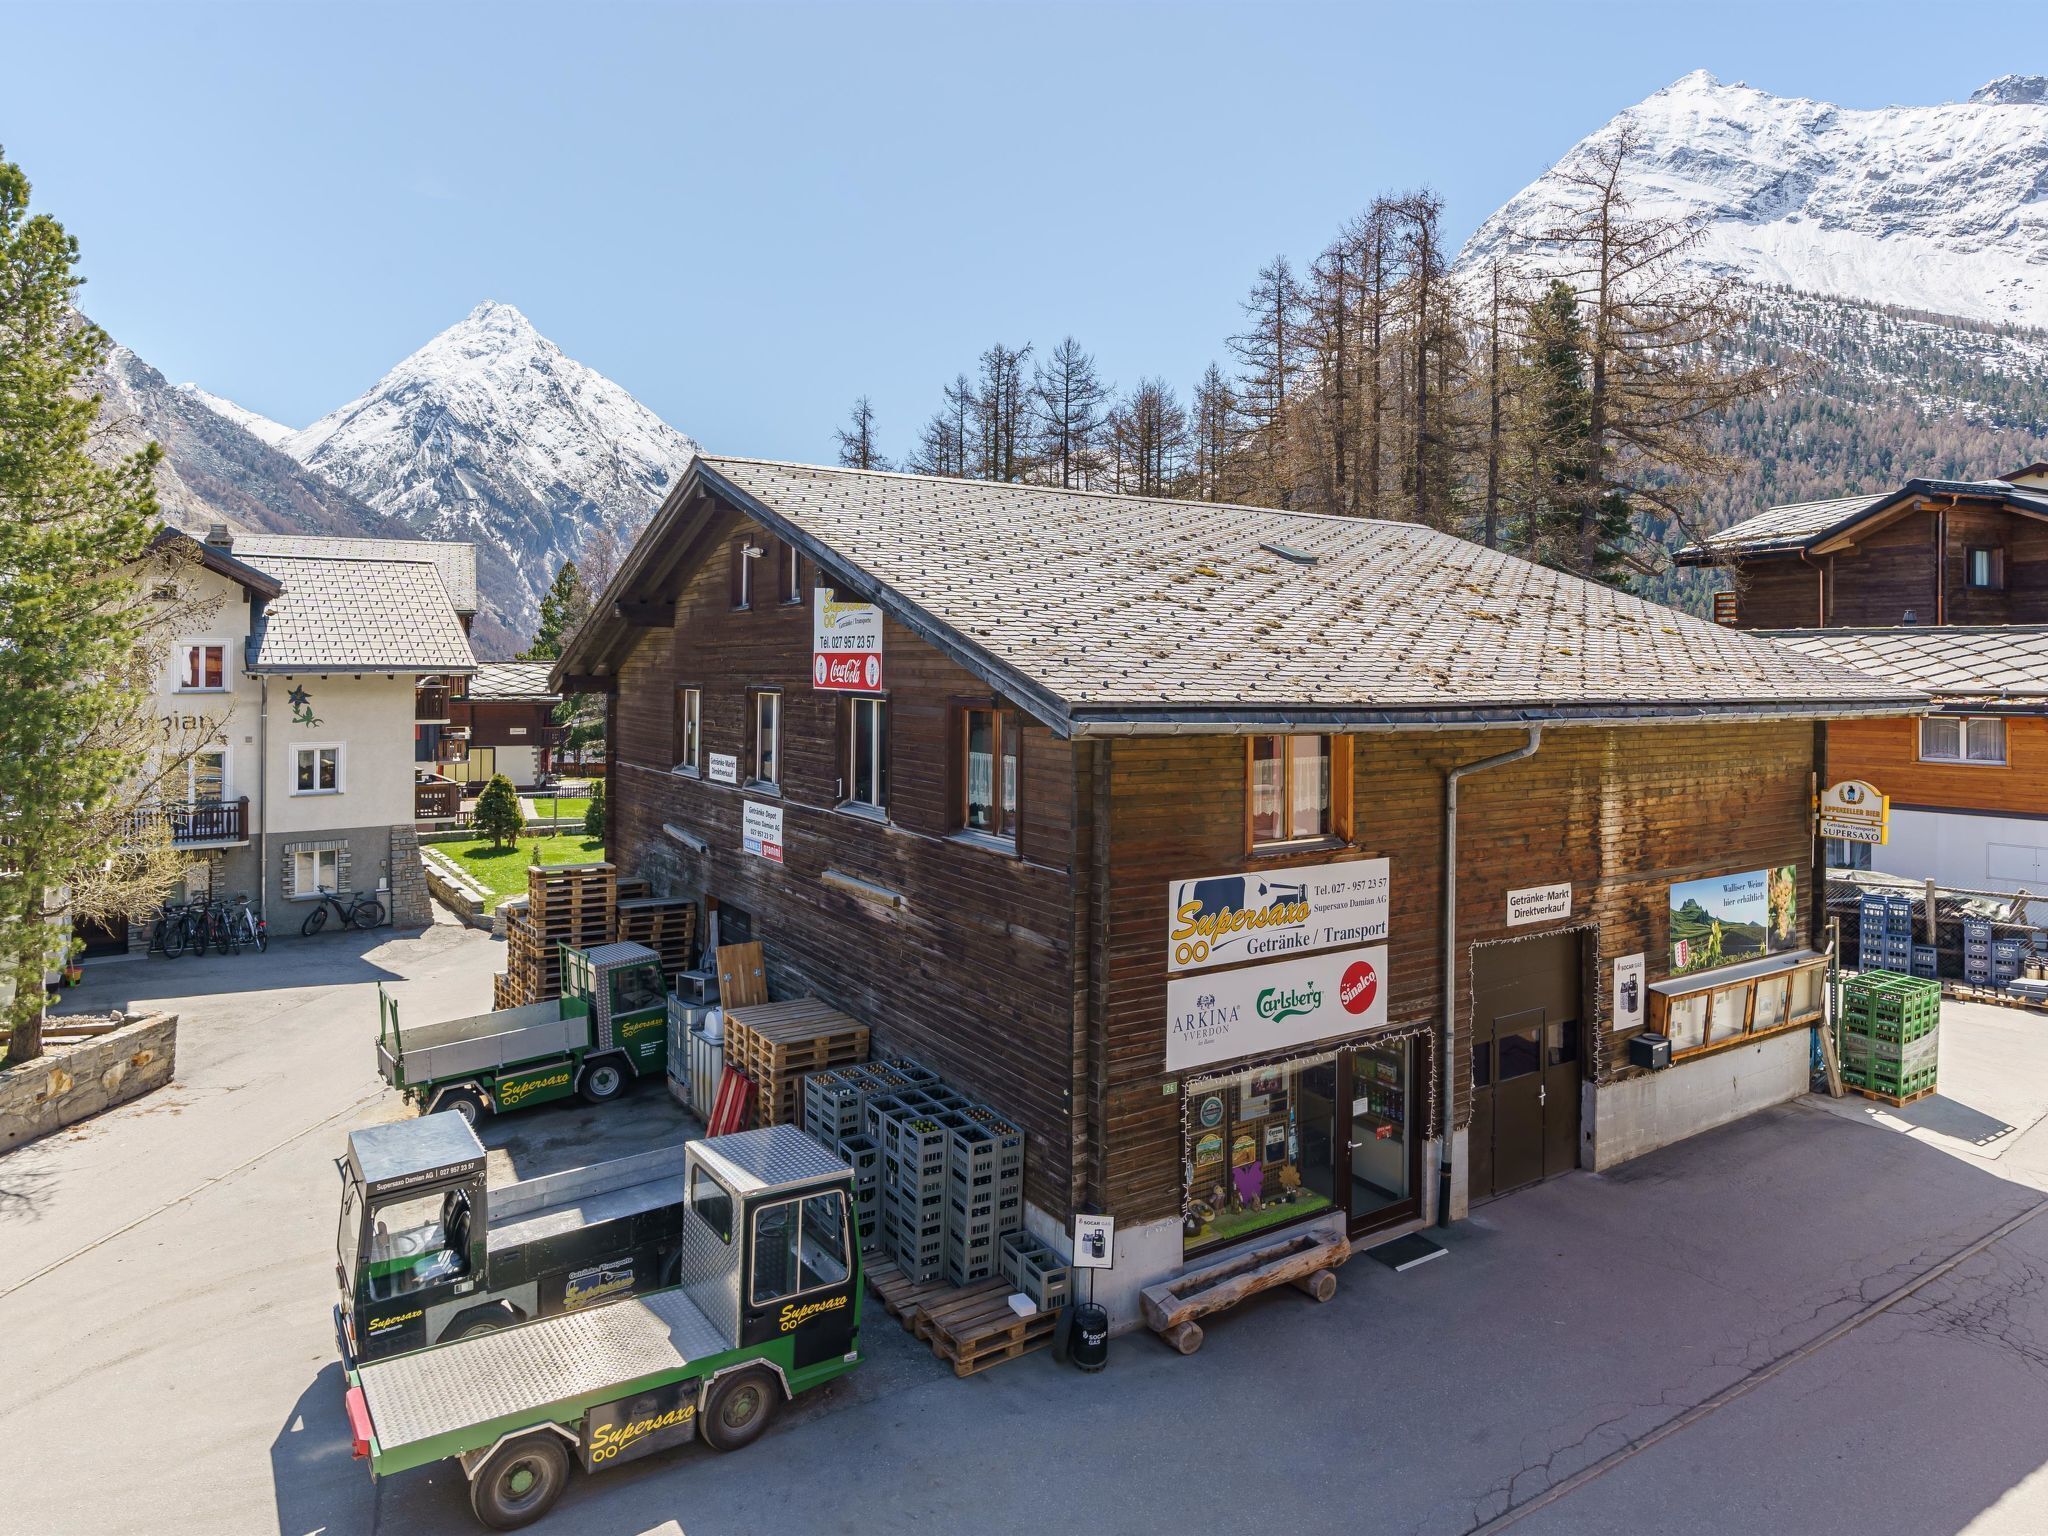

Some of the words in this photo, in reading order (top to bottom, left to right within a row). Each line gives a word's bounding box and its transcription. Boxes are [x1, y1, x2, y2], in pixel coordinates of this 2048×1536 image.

[820, 635, 830, 649] Tél.
[832, 635, 843, 649] 027
[844, 635, 856, 649] 957
[857, 635, 865, 649] 23
[867, 635, 875, 649] 57
[765, 810, 777, 820] Depot
[1823, 828, 1880, 842] SUPERSAXO
[1314, 884, 1331, 896] Tel.
[1332, 882, 1345, 894] 027
[1352, 880, 1366, 891] 957
[1368, 879, 1378, 889] 23
[1378, 877, 1388, 888] 57
[1723, 883, 1746, 893] Walliser
[1747, 879, 1764, 889] Weine
[1313, 902, 1348, 913] Supersaxo
[1349, 897, 1375, 908] Damian
[1376, 894, 1387, 904] AG
[1510, 889, 1570, 906] Getränke-Markt
[1723, 898, 1736, 907] hier
[1737, 891, 1765, 904] erhältlich
[1514, 901, 1566, 919] Direktverkauf
[1170, 900, 1312, 946] Supersaxo
[1247, 932, 1310, 955] Getränke
[1323, 920, 1386, 943] Transport
[1340, 971, 1377, 1006] Sinalco
[1256, 986, 1322, 1020] Carlsberg
[621, 1018, 663, 1033] Supersaxo
[1172, 1007, 1239, 1033] ARKINA
[1183, 1024, 1230, 1042] YVERDON
[500, 1073, 569, 1097] Supersaxo
[376, 1179, 404, 1191] Supersaxo
[405, 1174, 425, 1184] Damian
[425, 1171, 434, 1179] AG
[440, 1168, 450, 1176] 027
[450, 1166, 459, 1174] 957
[460, 1164, 468, 1172] 23
[468, 1162, 475, 1170] 57
[779, 1295, 848, 1322] Supersaxo
[368, 1309, 423, 1331] Supersaxo
[589, 1404, 696, 1450] Supersaxo
